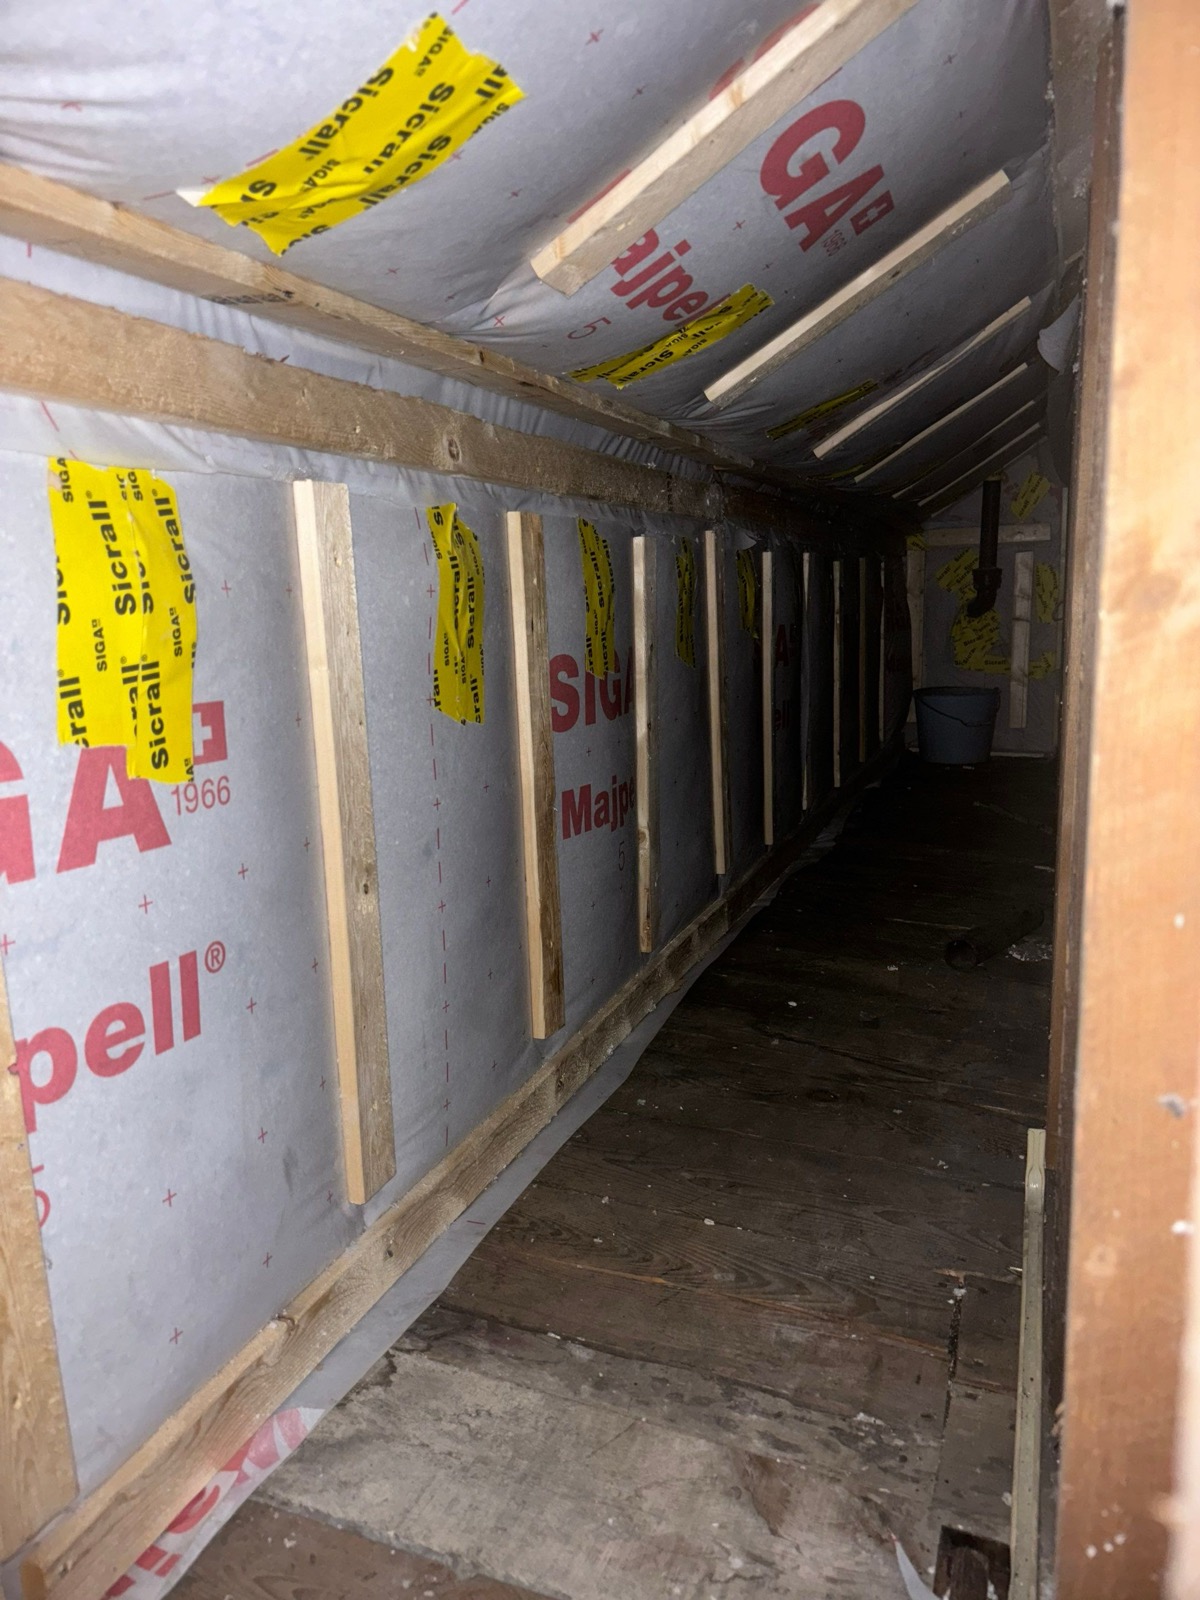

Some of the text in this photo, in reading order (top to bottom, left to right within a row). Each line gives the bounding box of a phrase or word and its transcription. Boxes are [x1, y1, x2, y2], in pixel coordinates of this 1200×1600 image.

[567, 316, 612, 340] 5
[171, 775, 232, 817] 1966
[618, 840, 626, 872] 5
